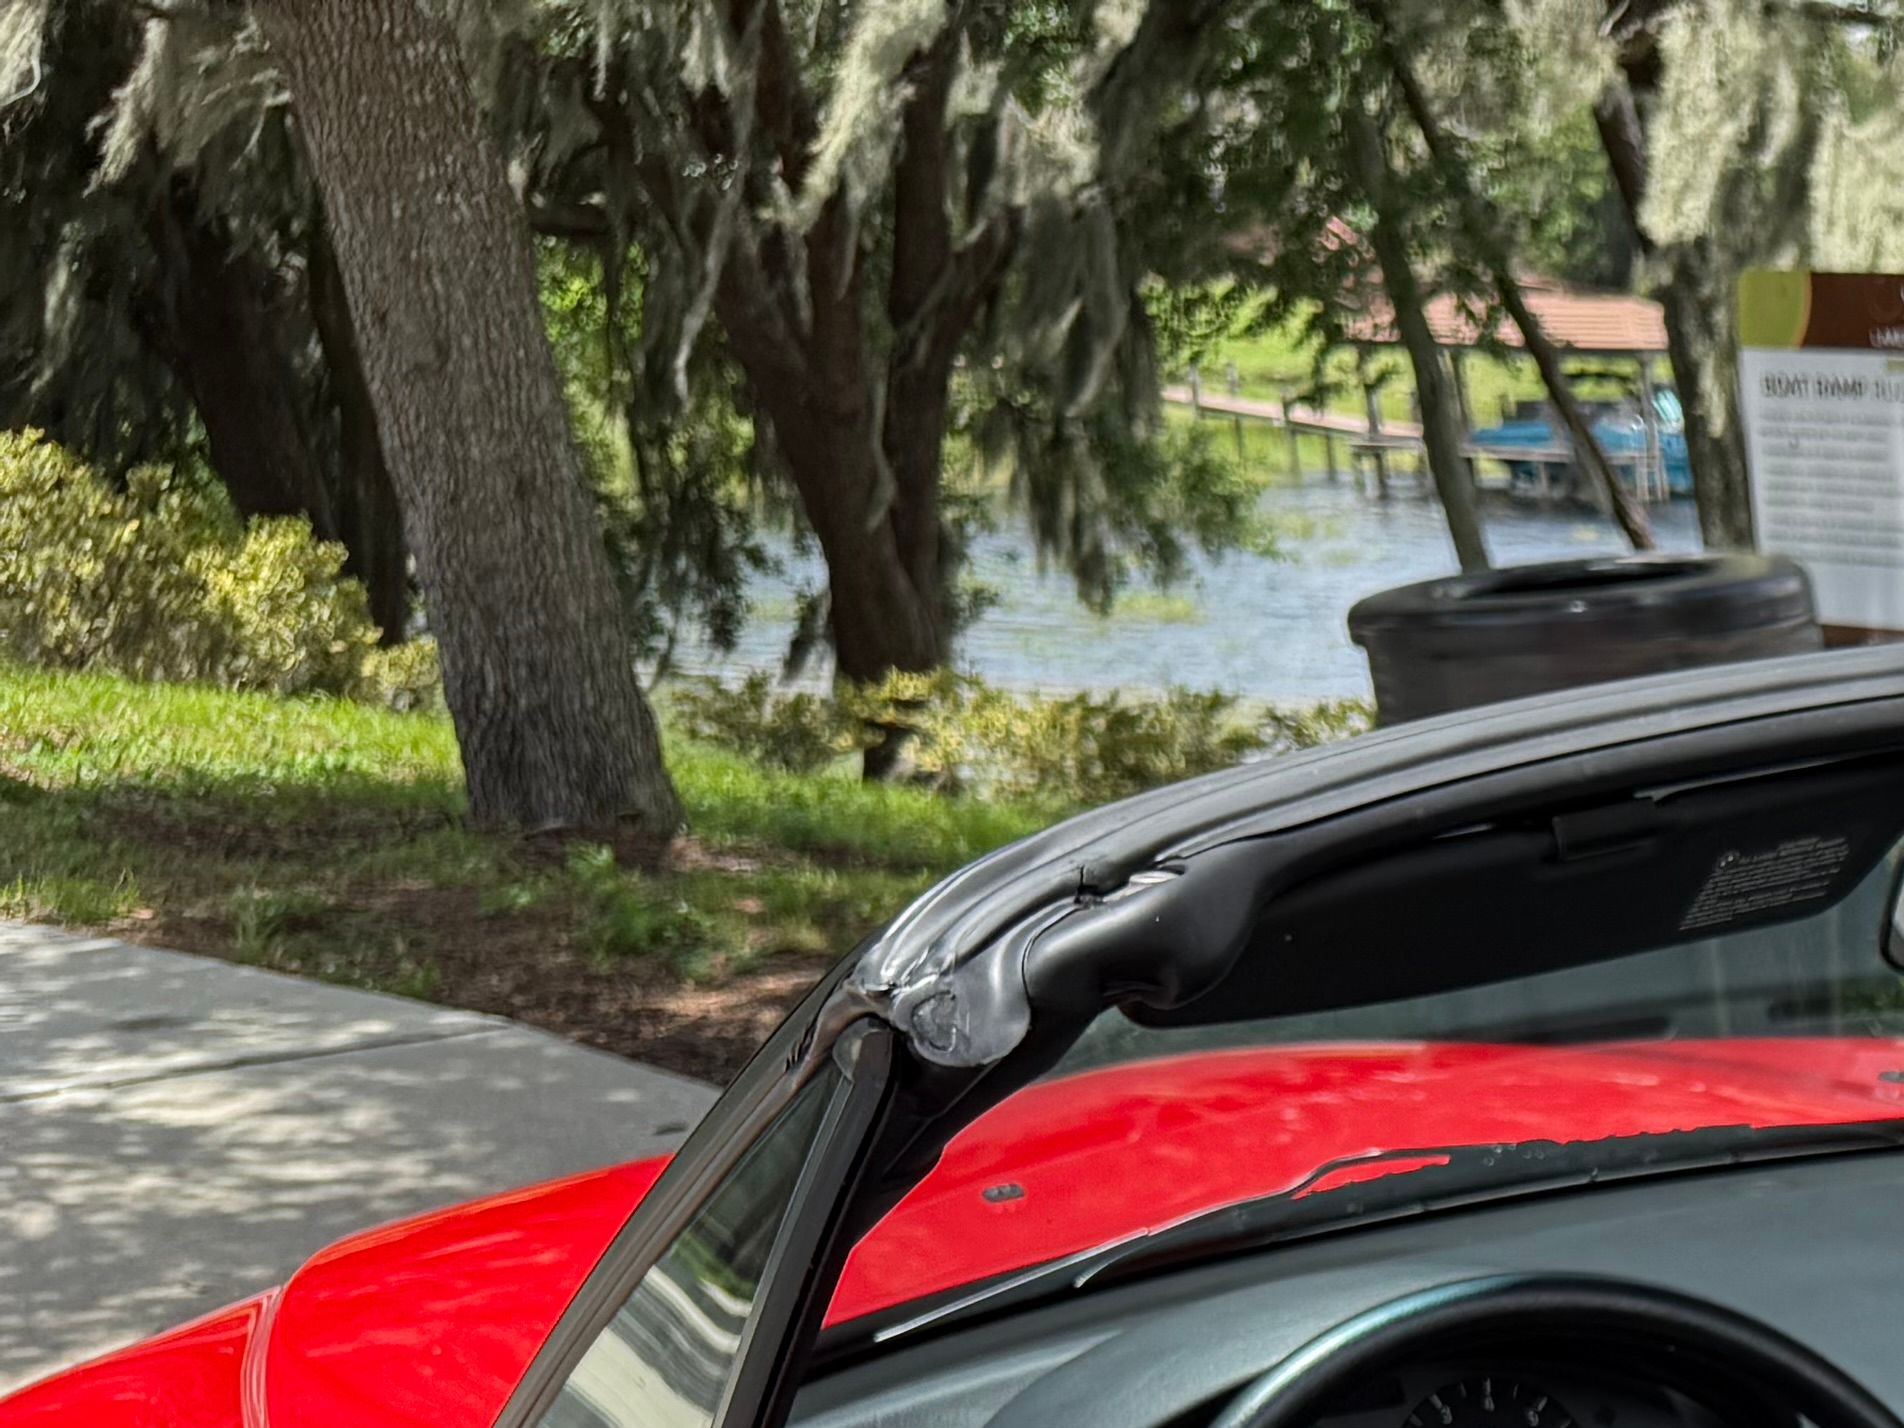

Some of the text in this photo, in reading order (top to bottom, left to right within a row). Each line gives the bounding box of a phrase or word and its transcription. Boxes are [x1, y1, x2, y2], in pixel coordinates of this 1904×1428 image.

[1760, 371, 1809, 398] BOAT
[1814, 373, 1868, 400] RAMP
[1440, 1404, 1454, 1426] 3
